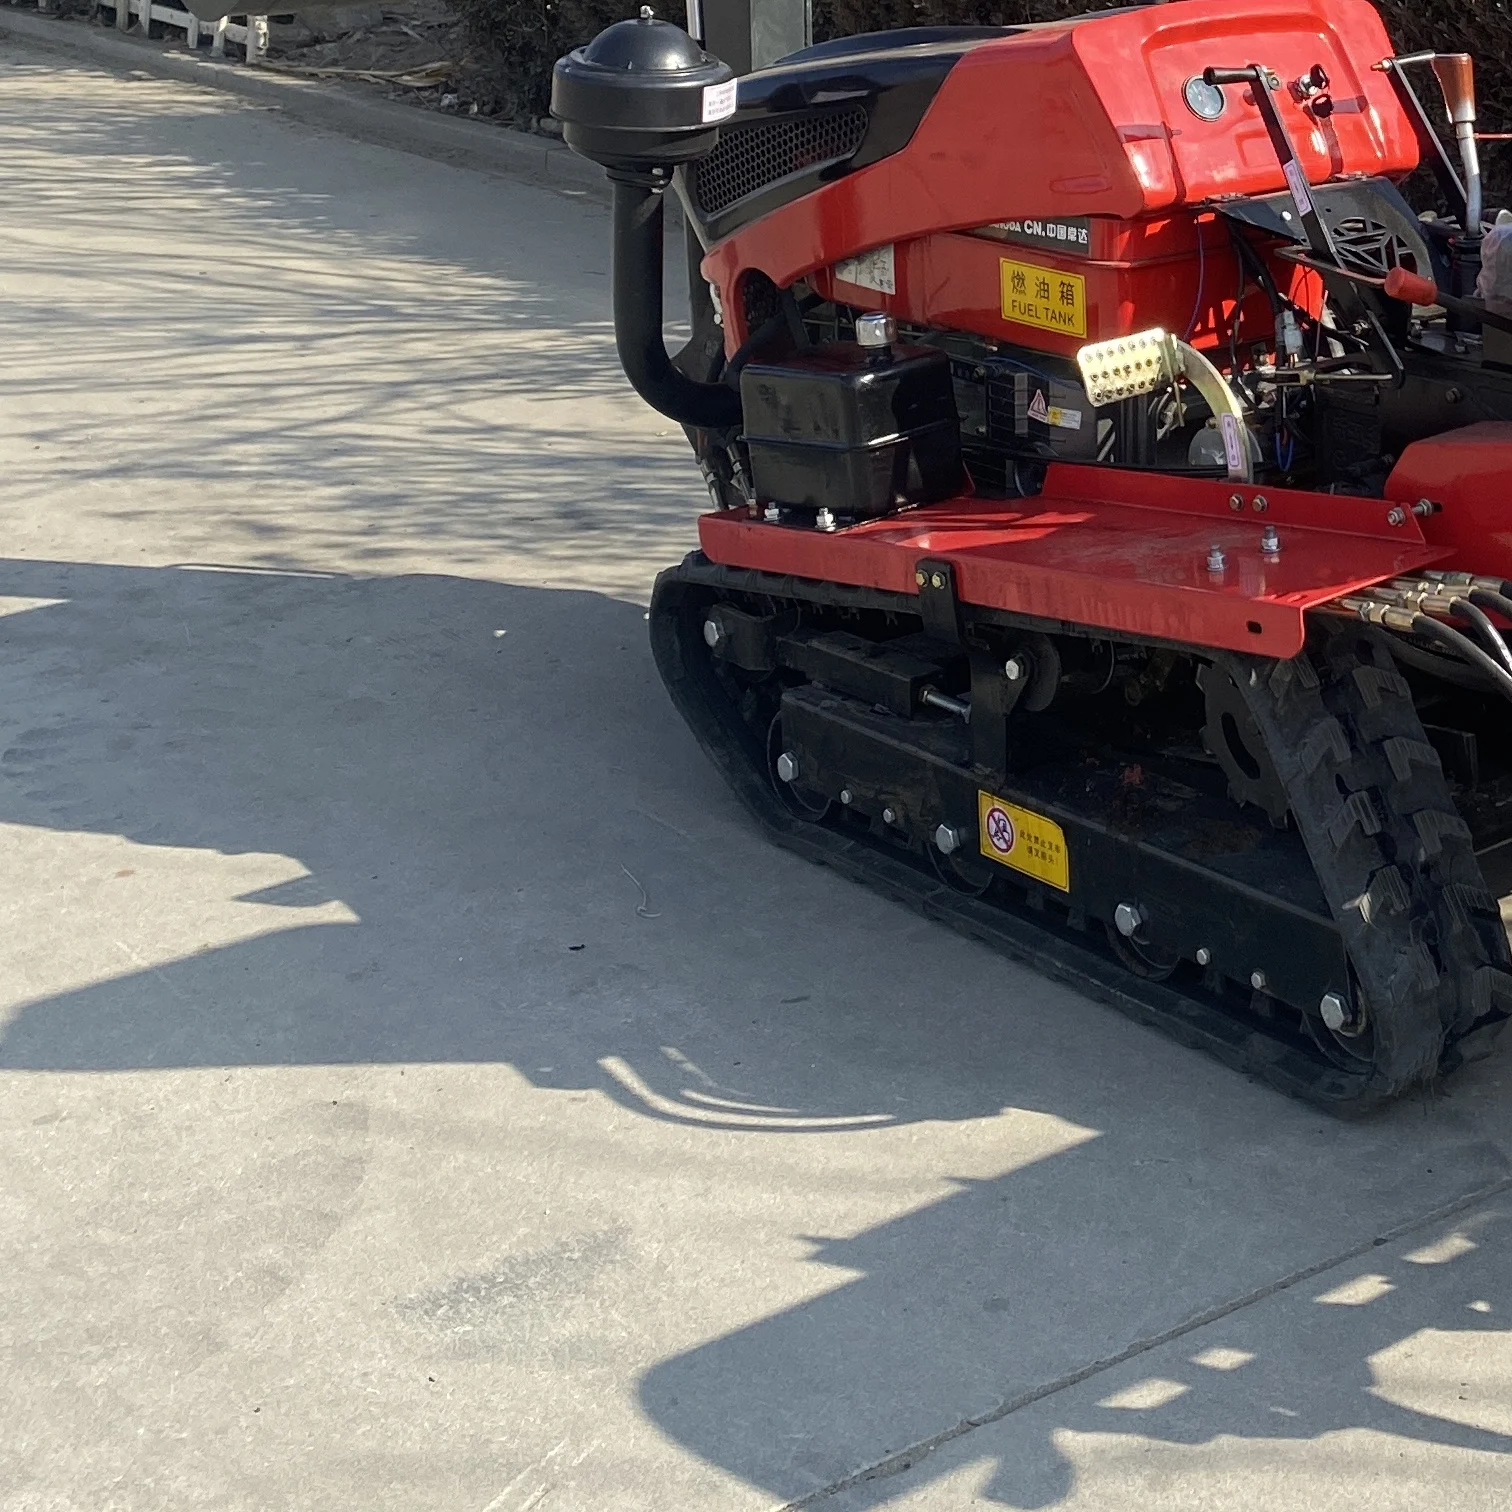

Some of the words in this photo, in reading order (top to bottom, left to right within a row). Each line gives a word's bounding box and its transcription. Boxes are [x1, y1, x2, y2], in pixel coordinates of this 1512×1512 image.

[1011, 269, 1074, 306] 燃油箱
[1012, 300, 1041, 319] FUEL
[1043, 307, 1075, 327] TANK
